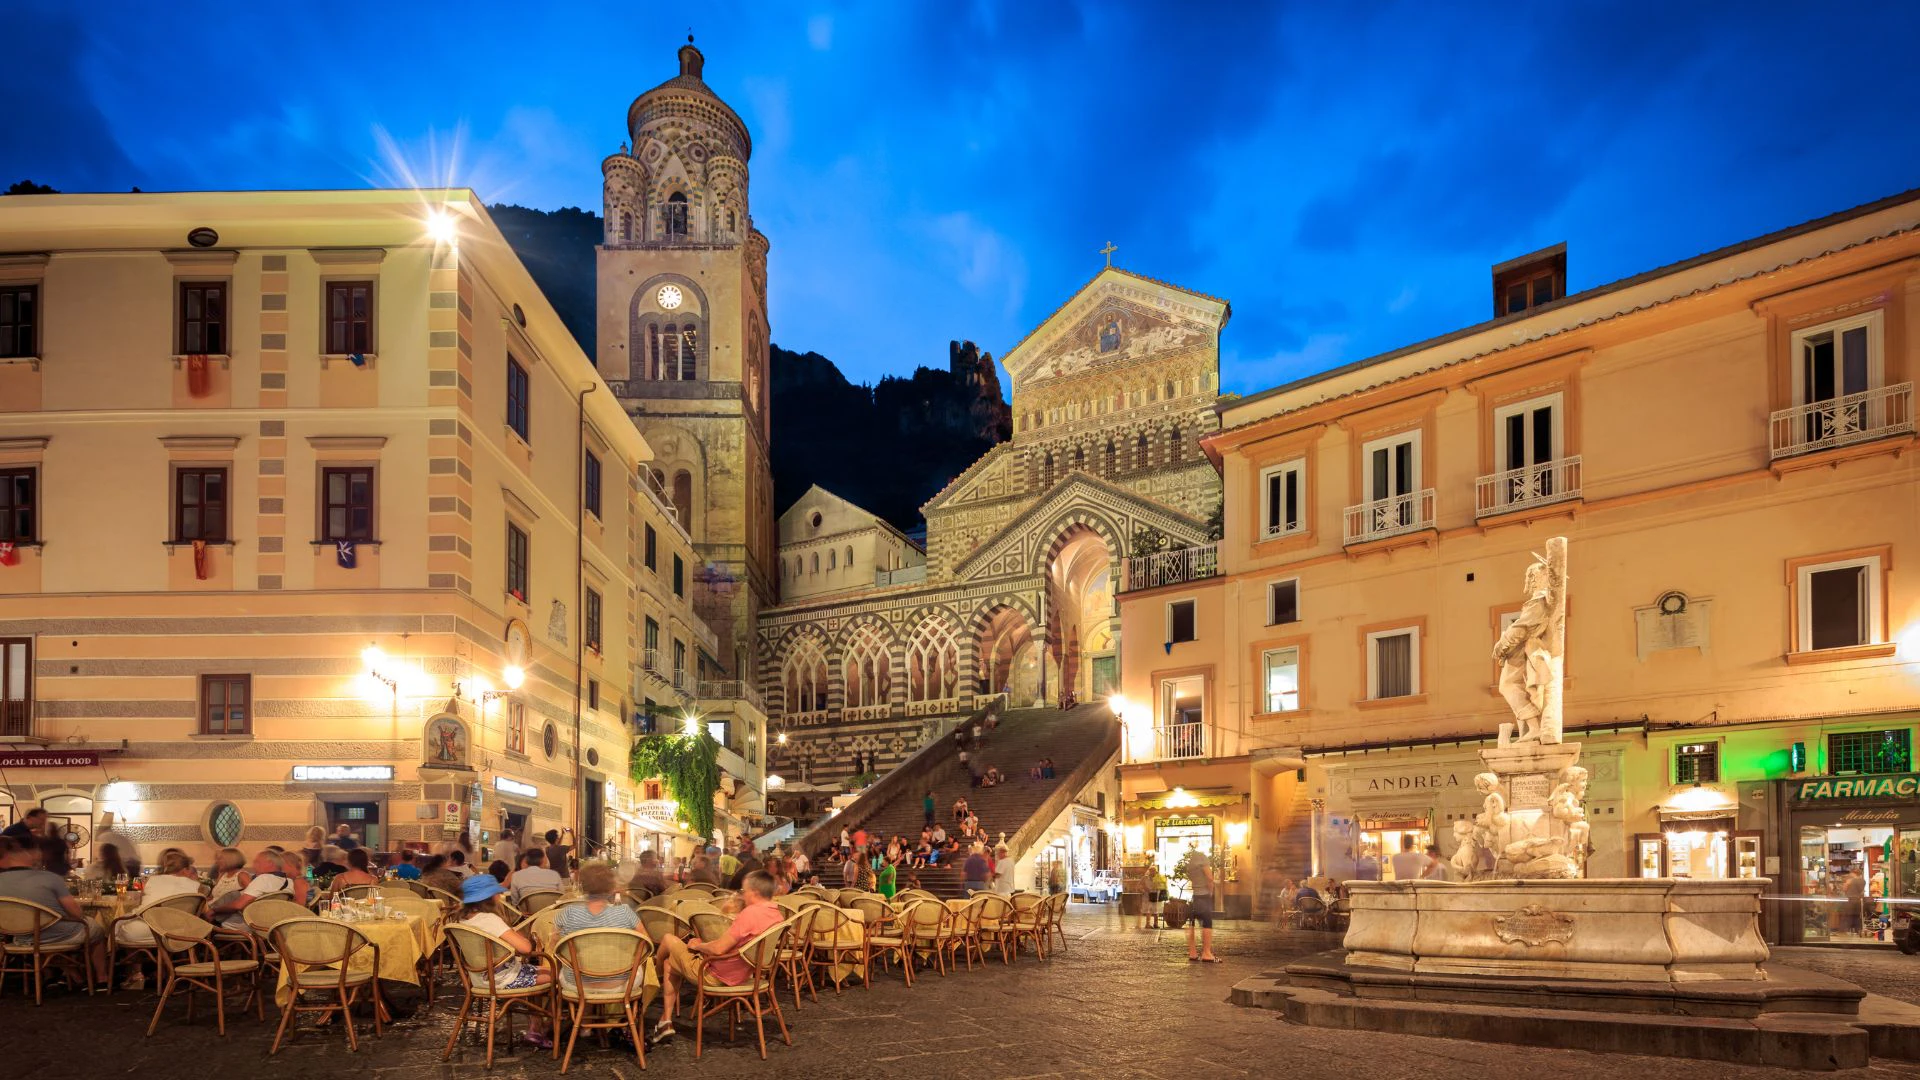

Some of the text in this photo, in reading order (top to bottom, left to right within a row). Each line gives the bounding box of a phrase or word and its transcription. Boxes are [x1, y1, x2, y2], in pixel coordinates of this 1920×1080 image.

[29, 758, 63, 766] TYPICAL
[66, 757, 91, 765] FOOD
[1369, 773, 1458, 790] ANDREA
[1840, 809, 1900, 822] Medaglia
